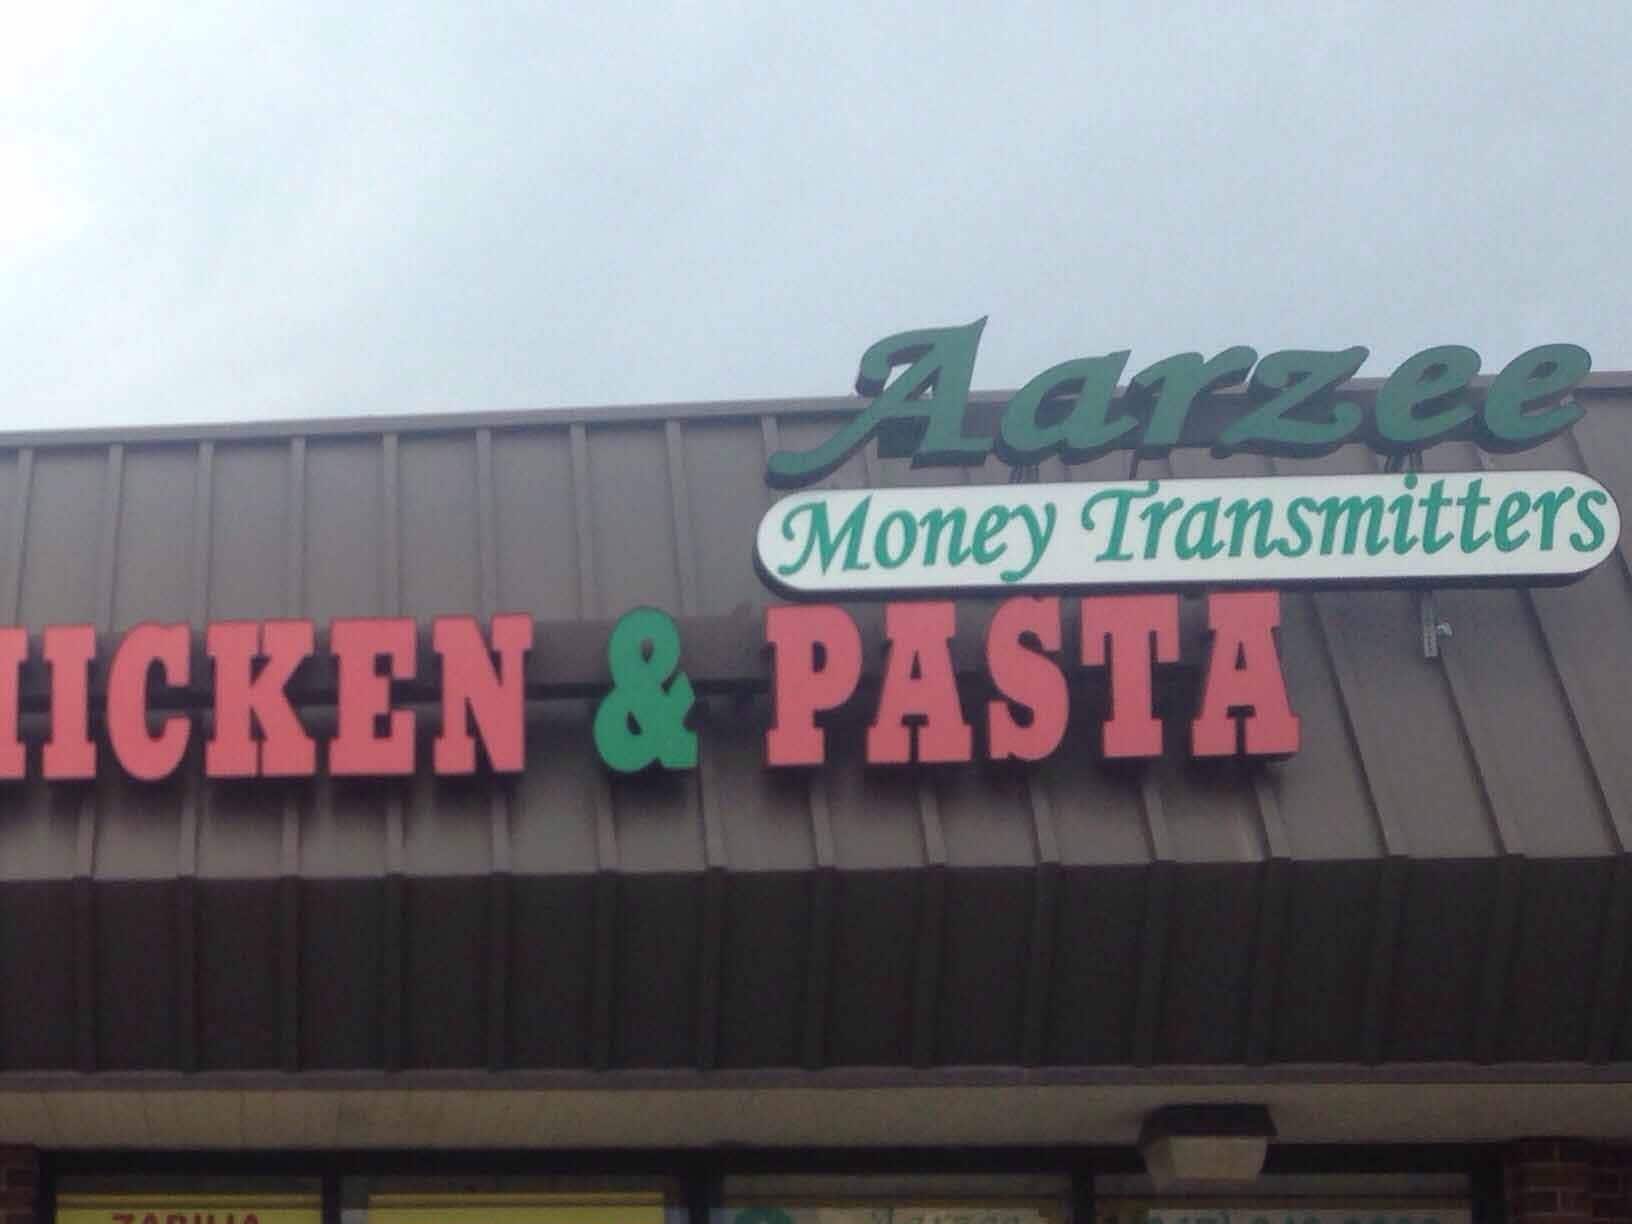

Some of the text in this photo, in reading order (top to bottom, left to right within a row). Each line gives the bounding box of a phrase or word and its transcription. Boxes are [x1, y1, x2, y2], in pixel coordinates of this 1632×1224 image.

[765, 315, 1592, 487] Aarzee
[779, 470, 1608, 582] Money Transmitters
[593, 606, 698, 772] &
[765, 590, 1301, 767] PASTA
